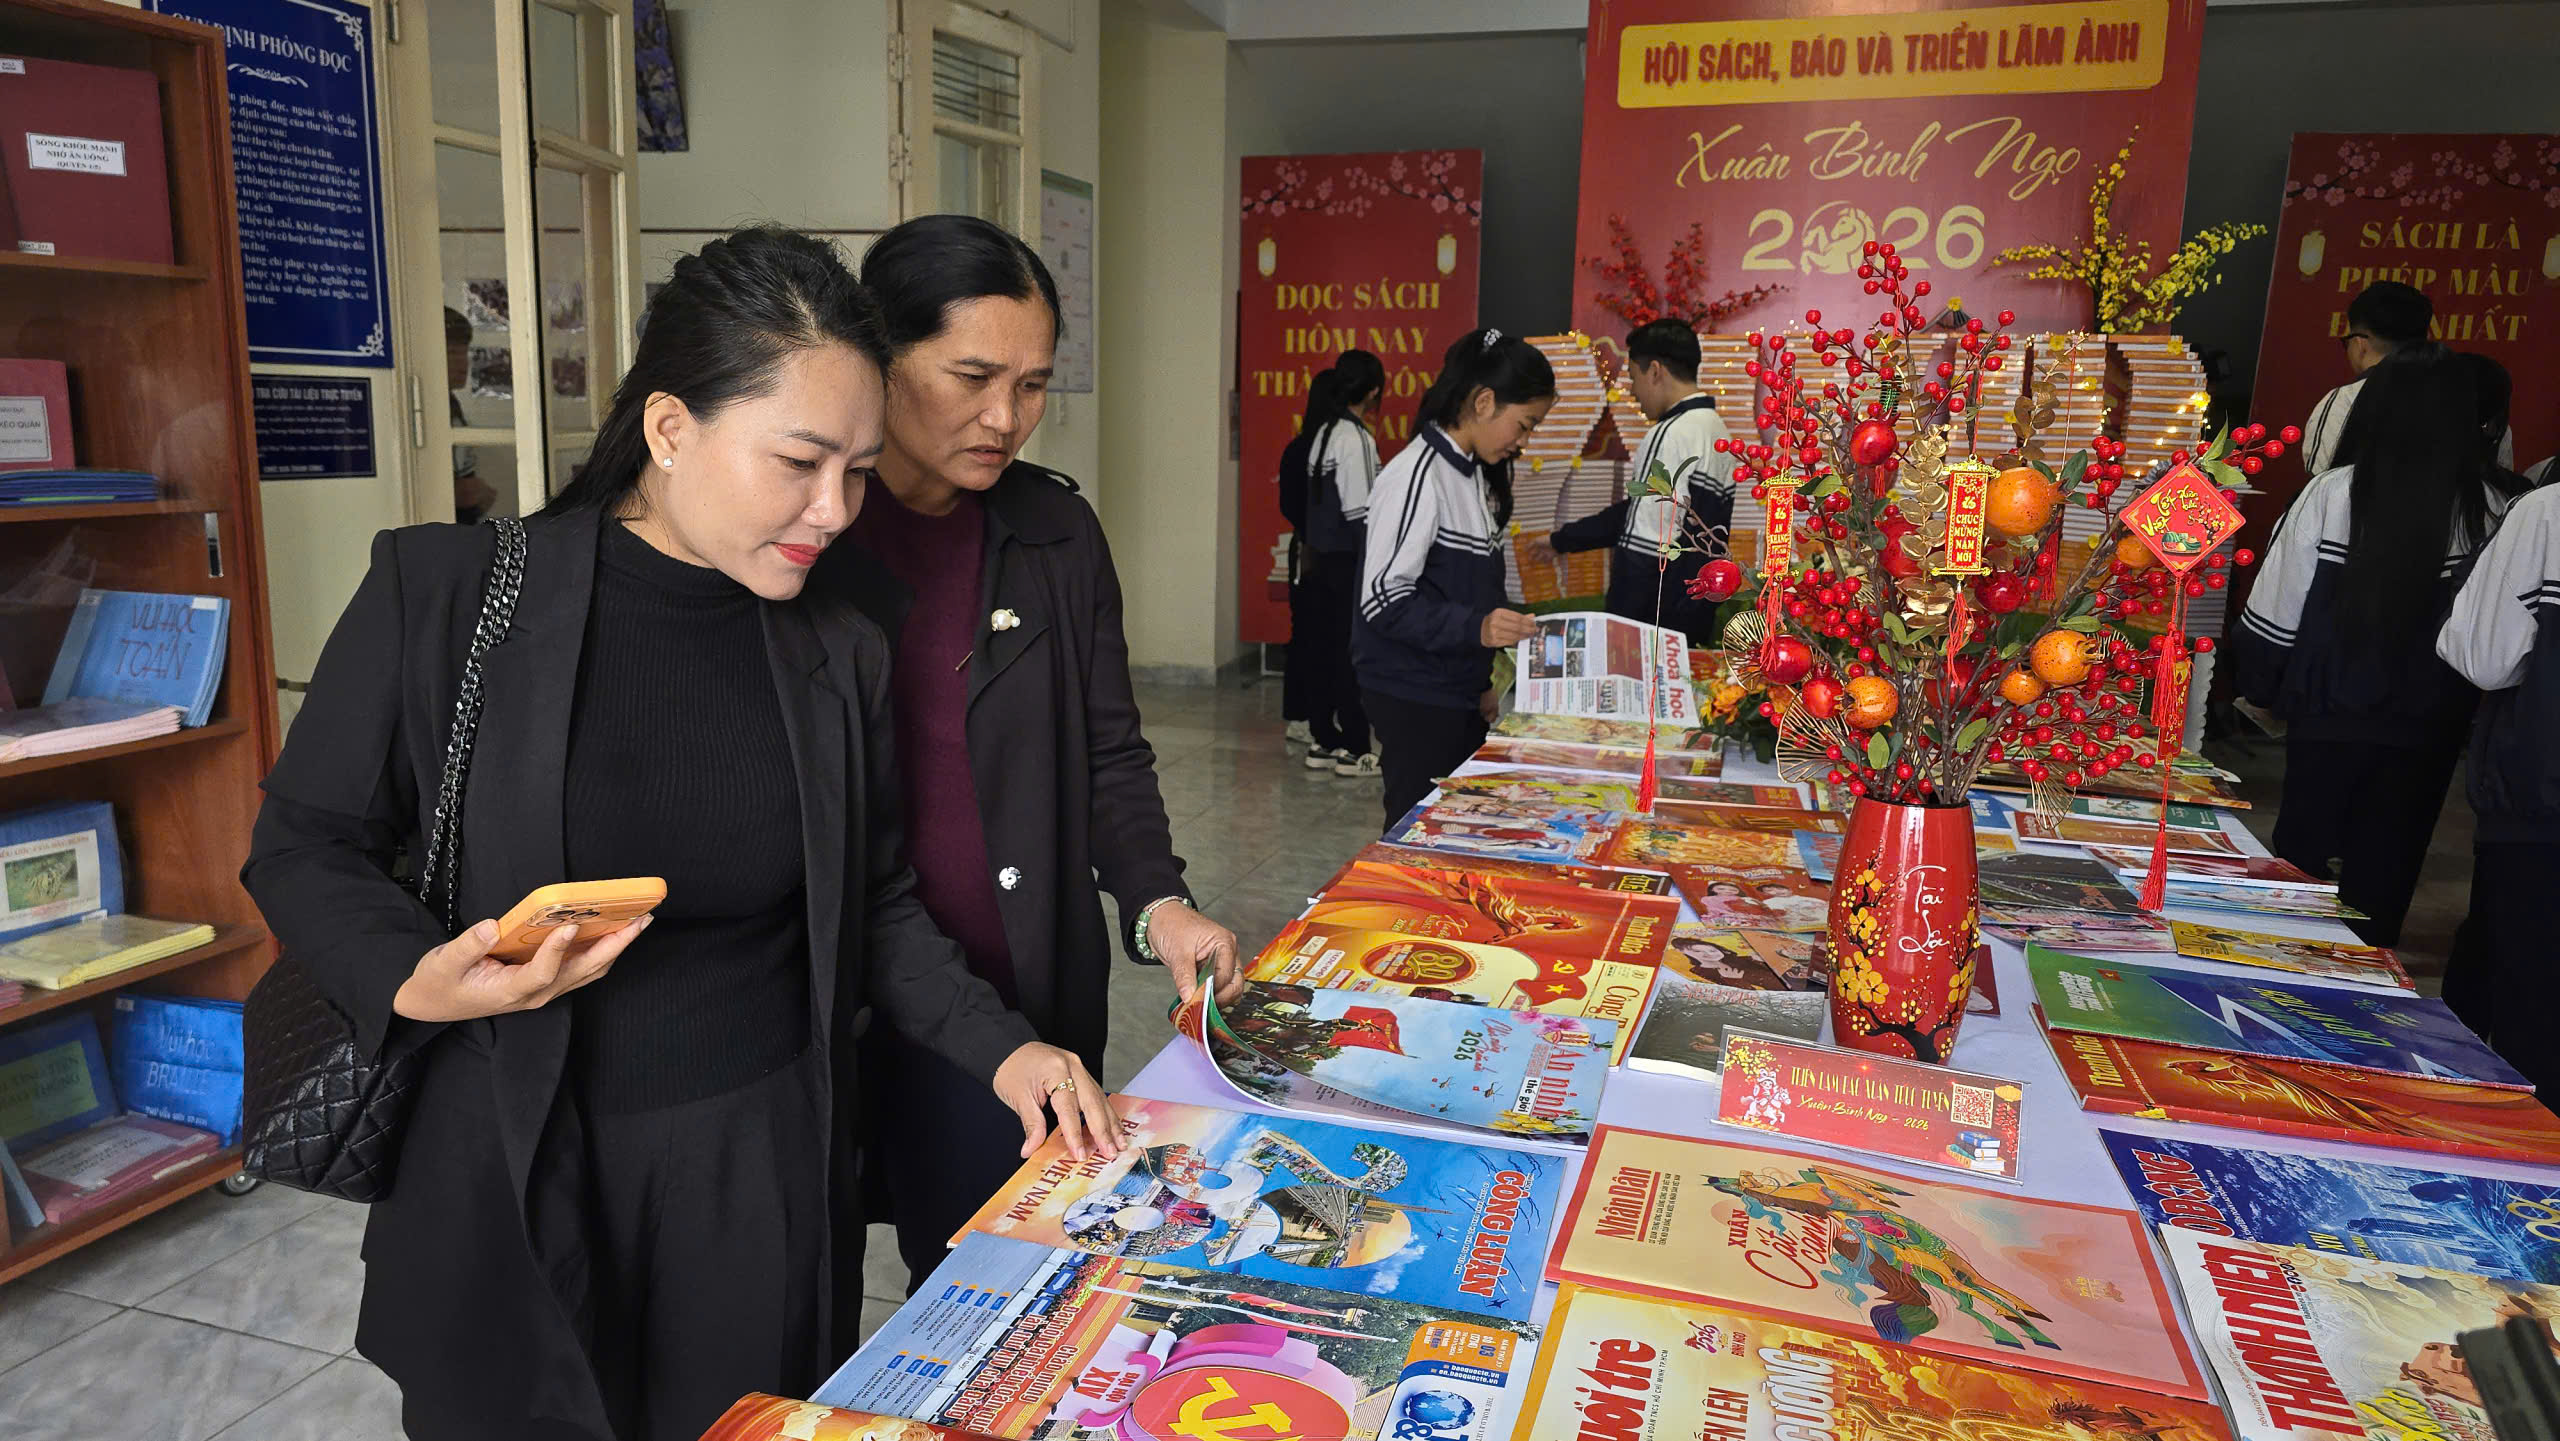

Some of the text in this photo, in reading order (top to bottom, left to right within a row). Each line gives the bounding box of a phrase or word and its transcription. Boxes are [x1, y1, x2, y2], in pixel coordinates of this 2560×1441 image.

[260, 34, 316, 64] PHÒNG
[319, 49, 351, 74] ĐỌC
[1644, 18, 2141, 89] HỘI SÁCH, BÁO VÀ TRIỂN LÃM ẢNH
[1675, 116, 2082, 201] Xuân Bính Ngọ
[1741, 199, 1986, 277] 2026
[2360, 215, 2521, 250] SÁCH LÀ
[1276, 277, 1440, 315] ĐỌC SÁCH
[2448, 262, 2533, 296] MÀU
[1285, 322, 1429, 353] HÔM NAY
[2428, 305, 2528, 341] NHẤT
[1253, 365, 1437, 398] THÀ CÔN
[1953, 525, 1979, 538] MỪNG
[1955, 513, 1979, 525] CHÚC
[1664, 633, 1681, 681] Khoa
[1453, 1028, 1483, 1062] 2026
[1547, 1045, 1587, 1072] An
[1524, 1079, 1539, 1095] thế
[1518, 1095, 1531, 1114] giới
[1121, 1118, 1141, 1138] BẢ
[1903, 1116, 1929, 1131] 2026
[1005, 1157, 1079, 1223] VIỆT NAM
[1594, 1165, 1653, 1241] Nhân Dân
[1458, 1170, 1530, 1298] CÔNG LUẬN
[1727, 1208, 1751, 1249] XUÂN
[1003, 1329, 1034, 1351] thứ
[1478, 1345, 1496, 1358] 03
[989, 1348, 1020, 1369] XIV
[1019, 1344, 1079, 1404] Chào mừng
[1576, 1337, 1657, 1391] trẻ
[1074, 1366, 1121, 1400] XIV
[1105, 1372, 1141, 1403] ĐẠI HỘI
[1757, 1347, 1835, 1441] CƯỜNG
[944, 1388, 986, 1420] Đảng
[1700, 1386, 1750, 1420] LÊN
[966, 1409, 998, 1435] quố
